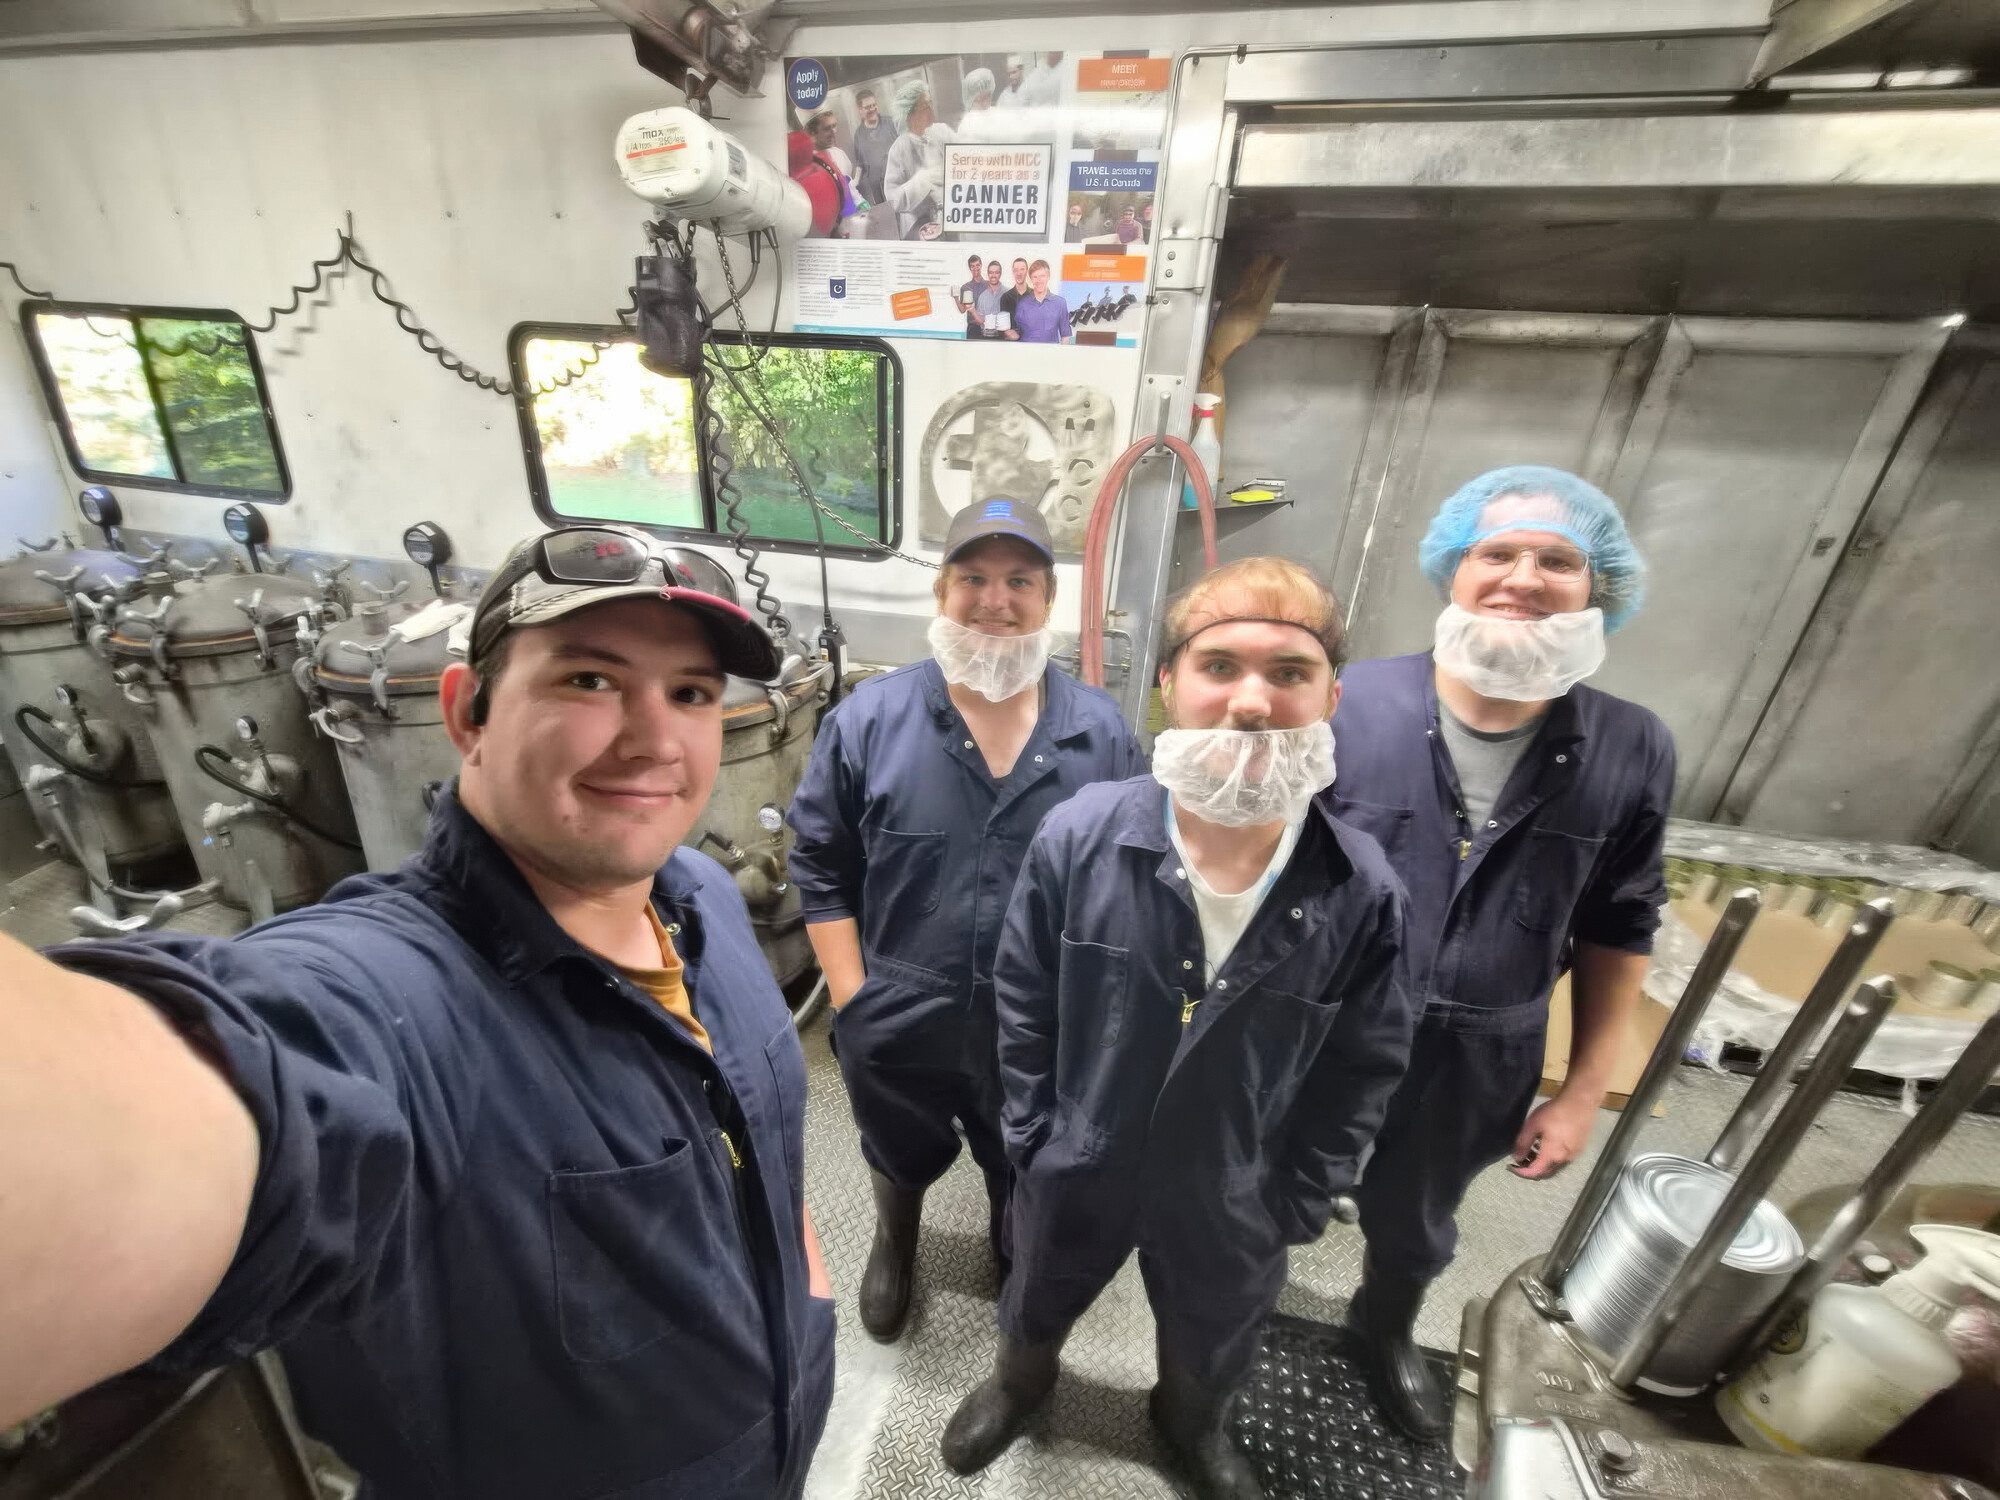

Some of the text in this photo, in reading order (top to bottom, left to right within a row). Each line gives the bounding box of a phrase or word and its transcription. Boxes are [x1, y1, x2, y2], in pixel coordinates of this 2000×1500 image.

[797, 69, 819, 83] Apply
[796, 84, 823, 99] today!
[951, 153, 1041, 166] Serve with MCC
[951, 167, 1040, 182] for 2 years as a
[1077, 166, 1110, 175] TRAVEL
[1085, 178, 1102, 187] U.S.
[1111, 178, 1141, 187] Canada
[951, 183, 1039, 204] CANNER
[951, 207, 1037, 225] OPERATOR
